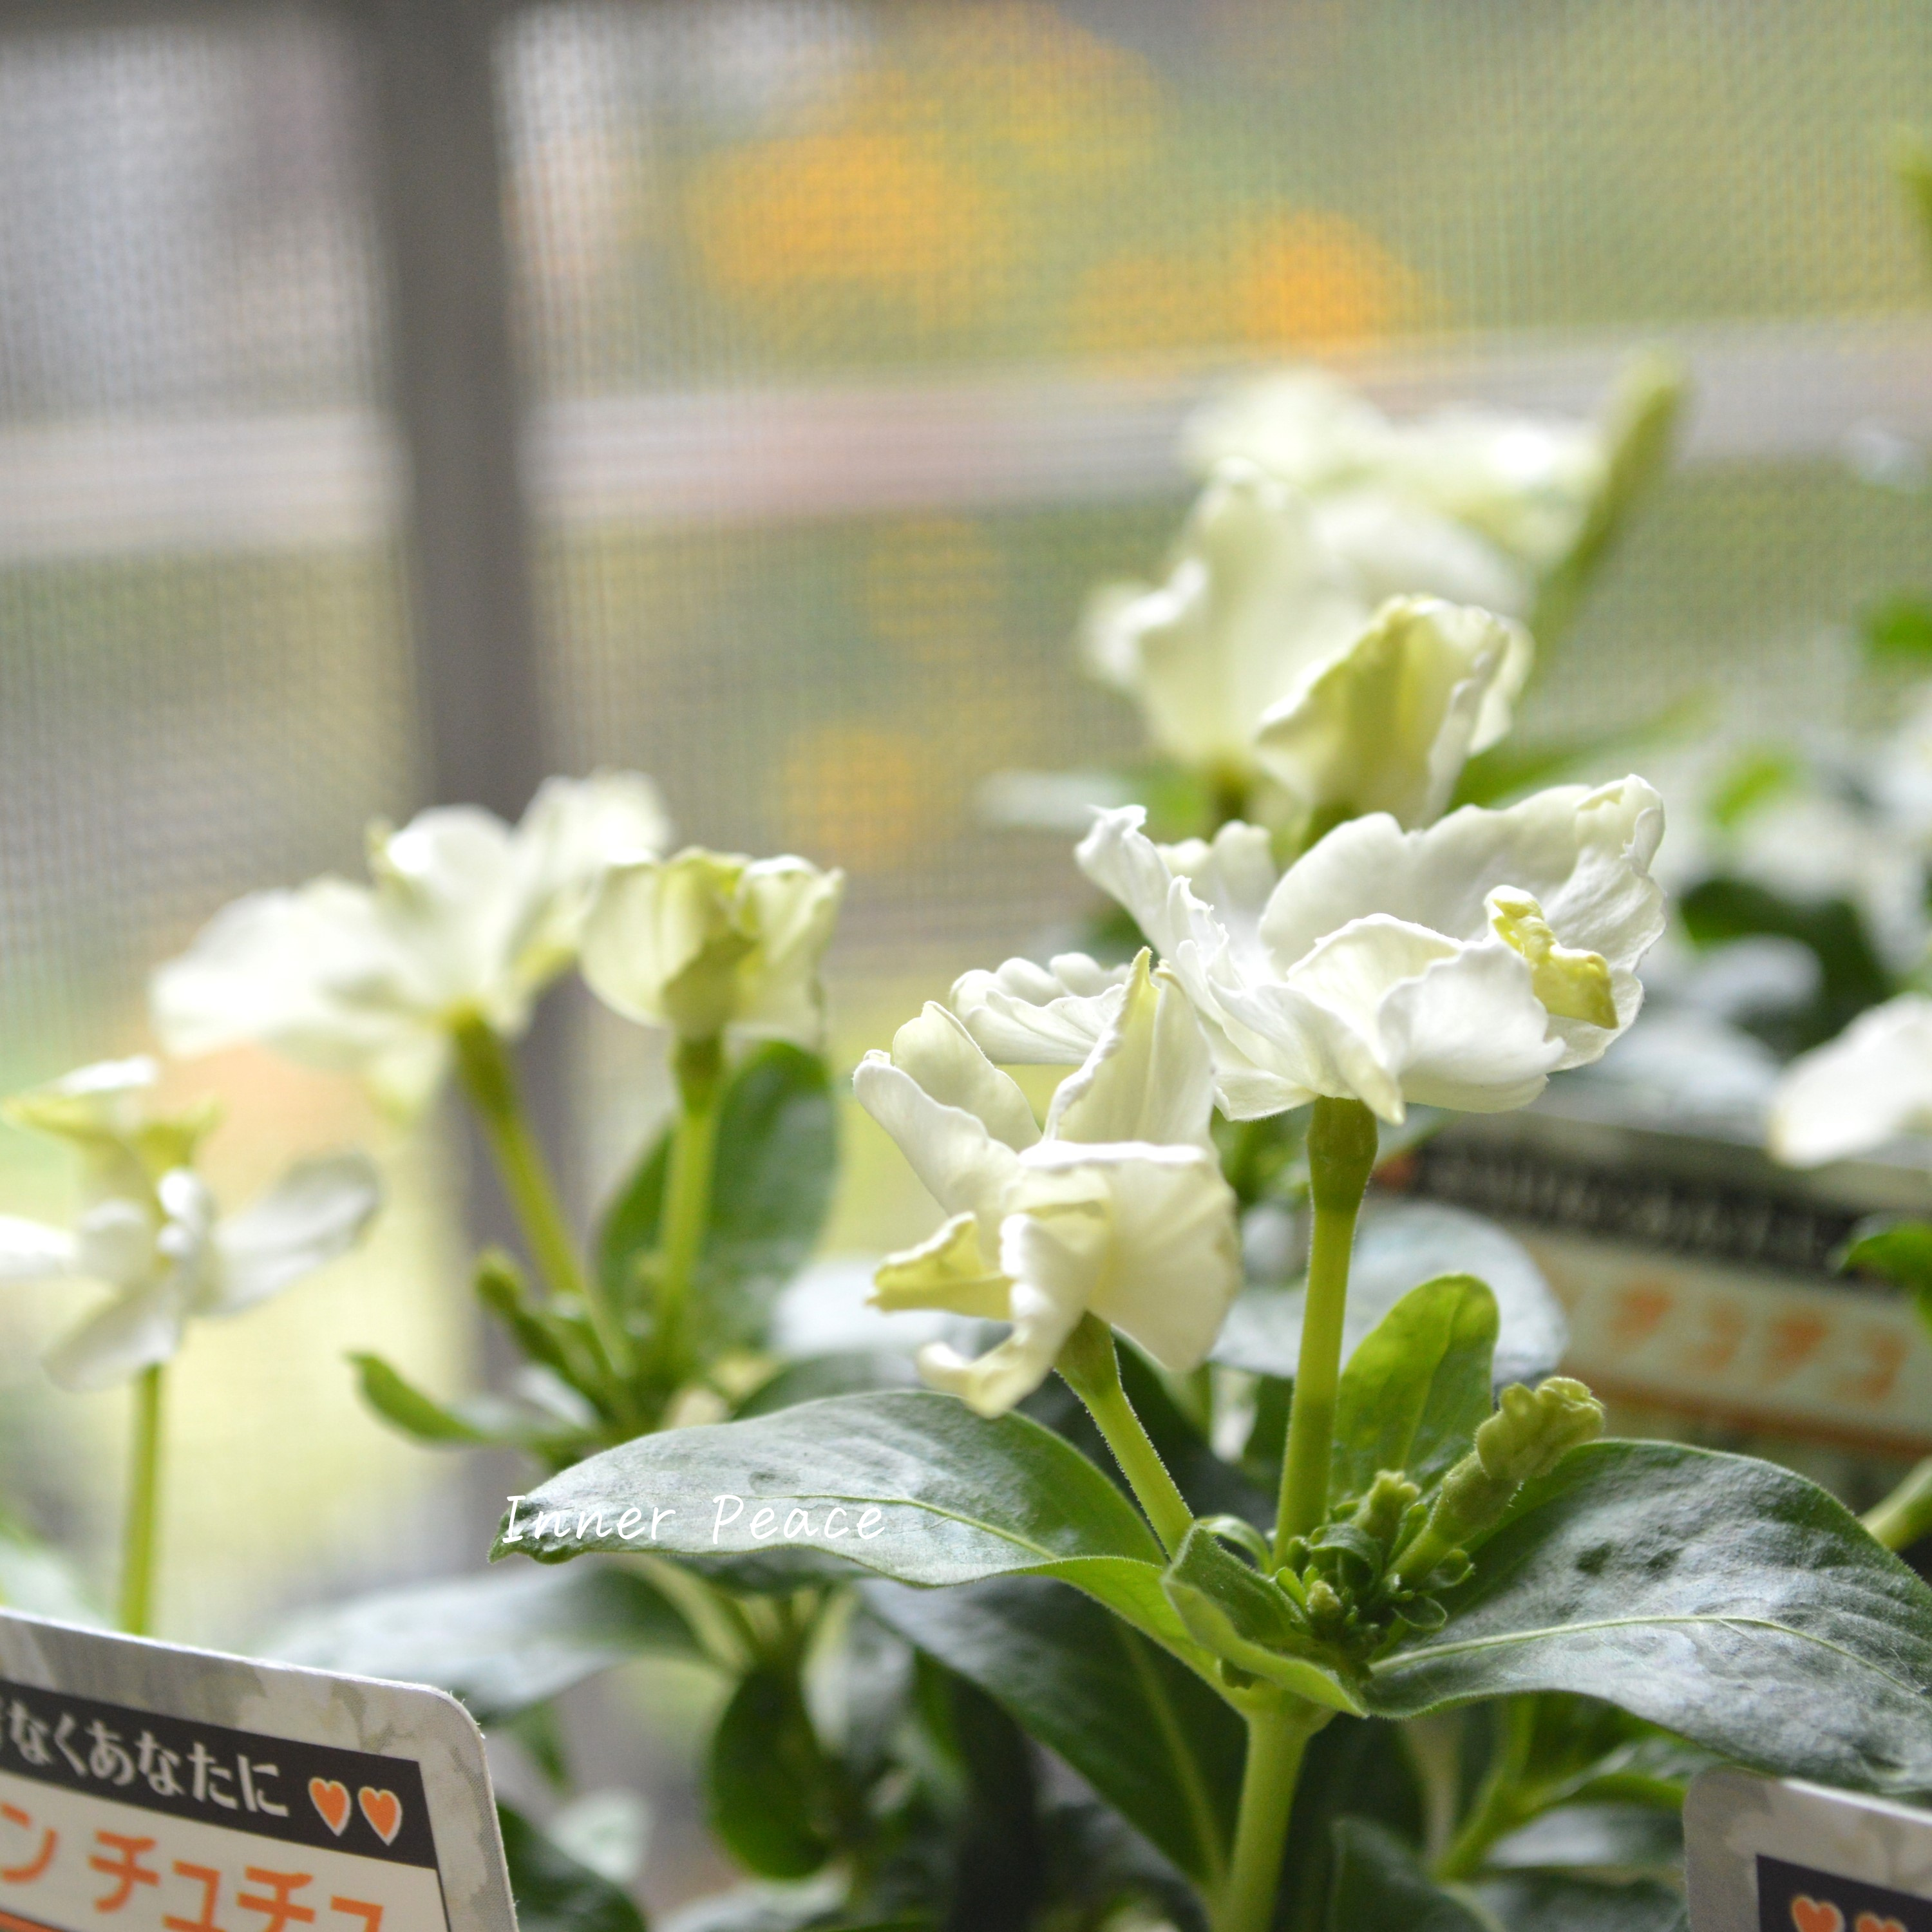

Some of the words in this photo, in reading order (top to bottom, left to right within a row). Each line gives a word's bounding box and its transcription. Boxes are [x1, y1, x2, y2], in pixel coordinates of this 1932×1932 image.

[0, 1695, 289, 1817] なくあなたに
